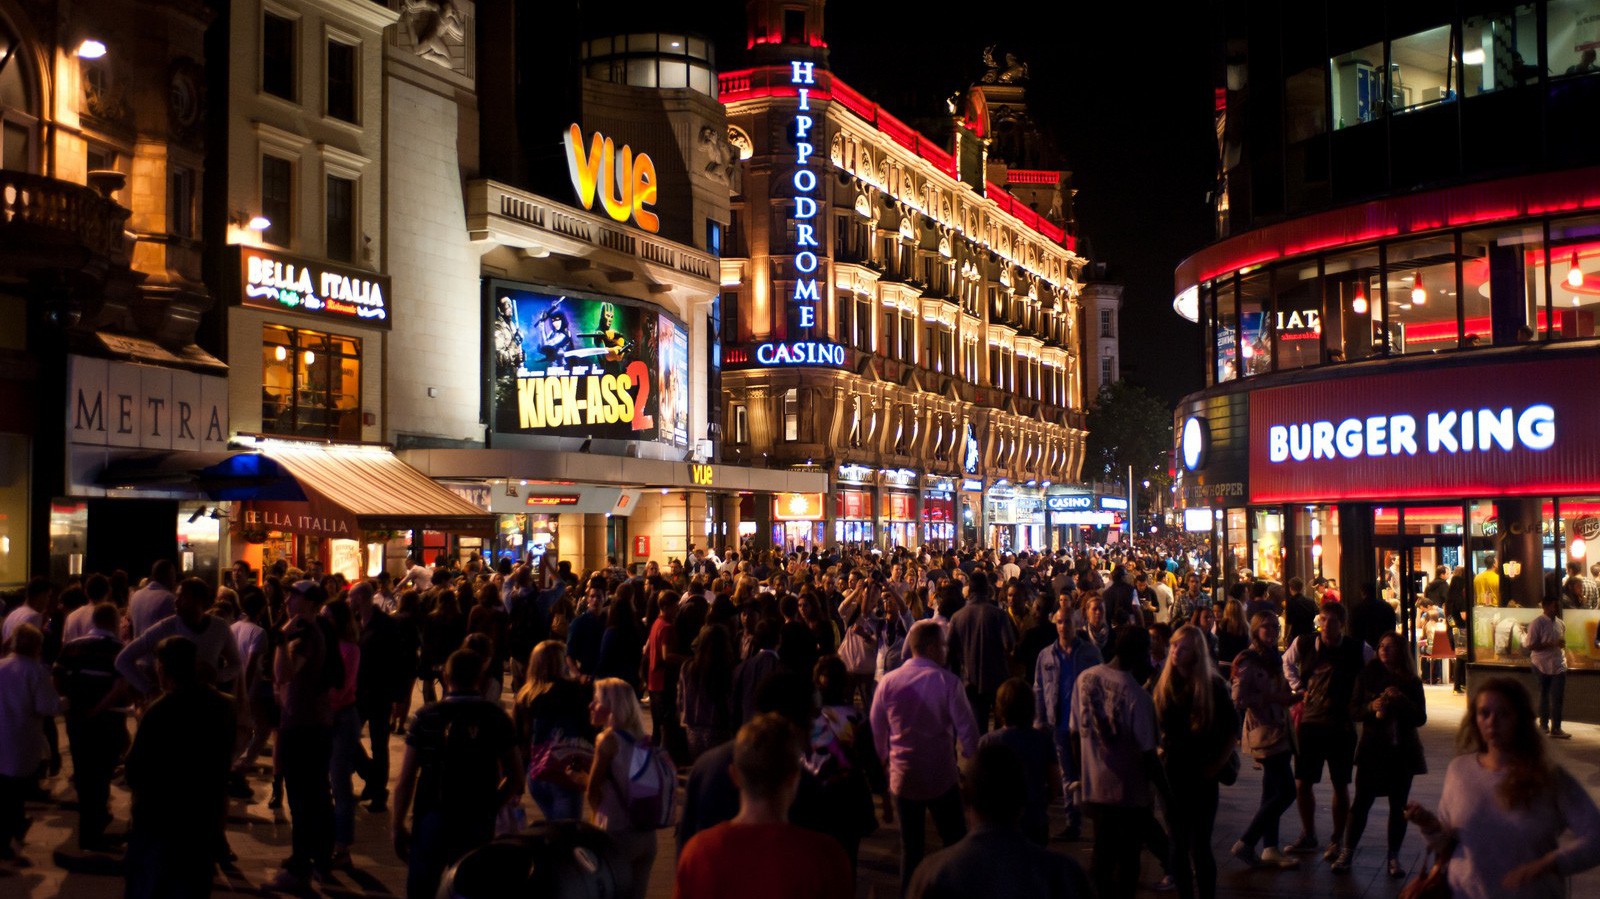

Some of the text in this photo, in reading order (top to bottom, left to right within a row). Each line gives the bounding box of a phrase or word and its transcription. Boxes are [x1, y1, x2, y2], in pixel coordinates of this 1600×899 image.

[791, 61, 820, 328] HIPPODROME
[248, 256, 314, 293] BELLA
[320, 272, 384, 307] ITALIA
[757, 342, 845, 366] CASINO
[74, 387, 224, 442] METRA
[517, 360, 654, 431] KICK-ASS 2
[1269, 403, 1556, 464] BURGER KING
[299, 516, 348, 533] ITALIA
[1048, 497, 1091, 508] CASINO
